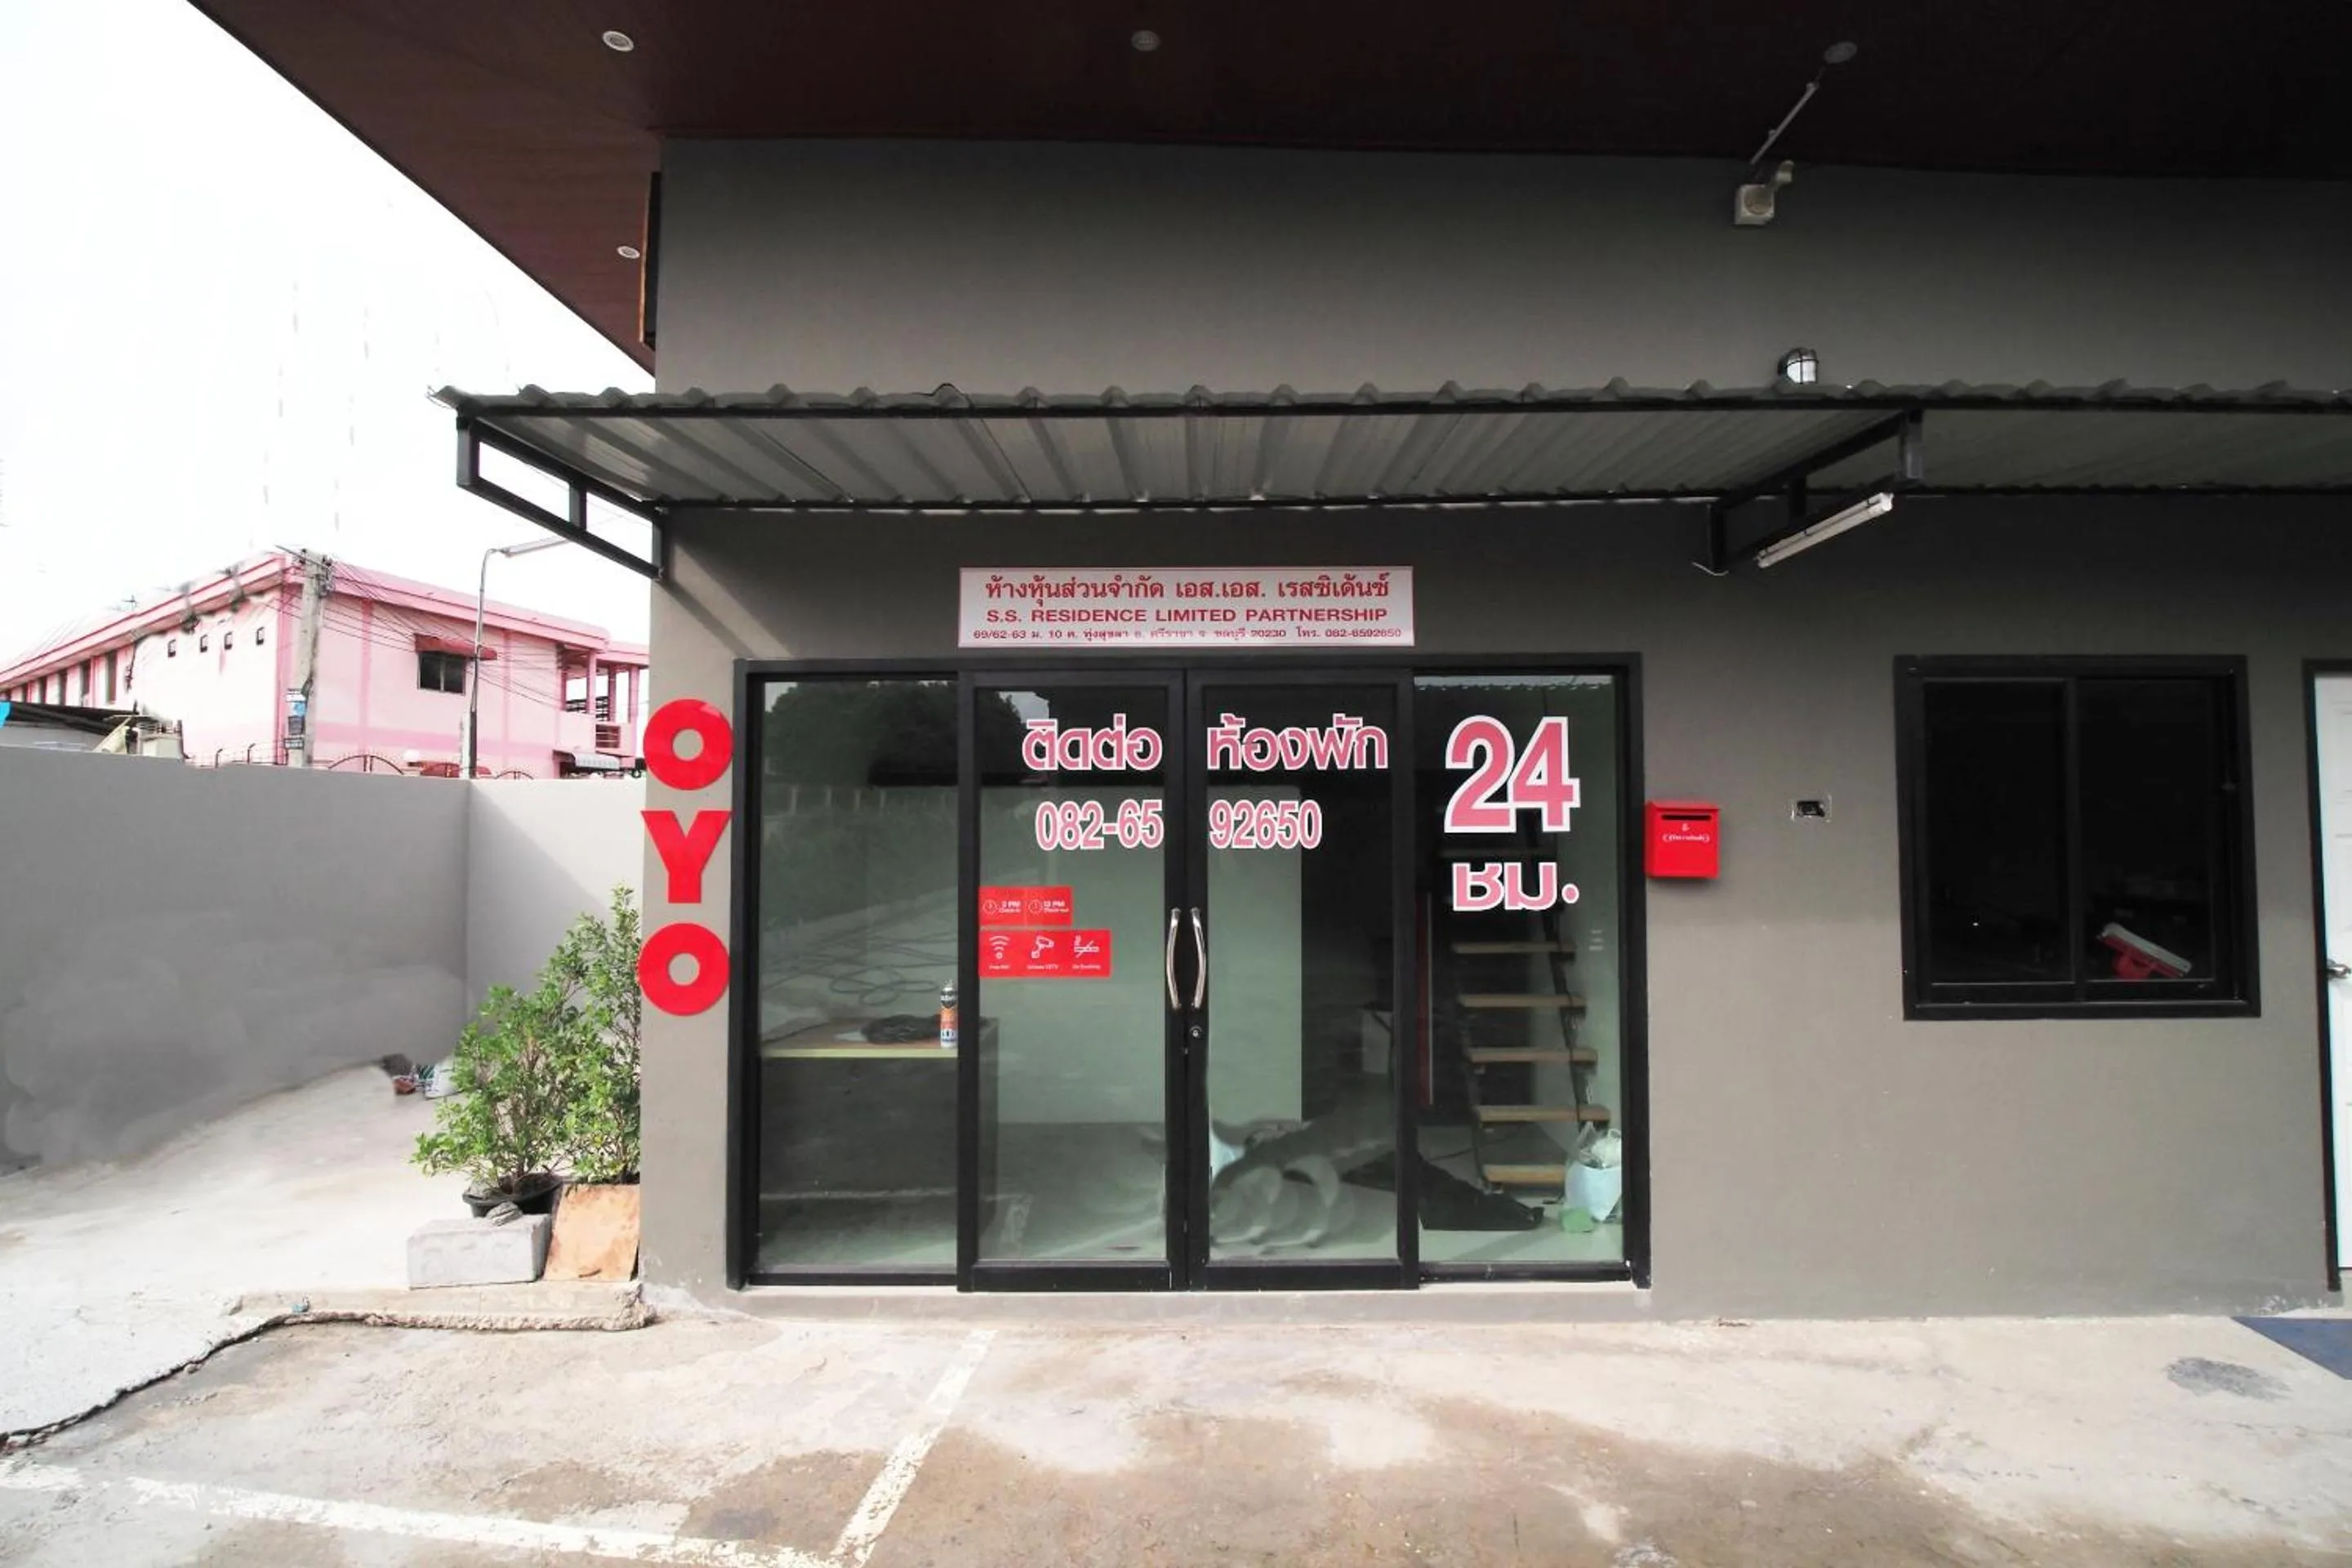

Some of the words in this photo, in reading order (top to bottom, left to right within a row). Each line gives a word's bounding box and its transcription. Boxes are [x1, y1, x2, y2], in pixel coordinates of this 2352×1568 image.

[985, 574, 1164, 607] ห้างหุ้นส่วนจำกัด
[1176, 581, 1267, 598] เอส.เอส.
[1278, 572, 1390, 598] เรสซิเด้นซ์
[987, 609, 1022, 623] S.S.
[1031, 609, 1147, 622] RESIDENCE
[1156, 608, 1236, 621] LIMITED
[1245, 608, 1388, 621] PARTNERSHIP
[1022, 713, 1163, 771] ติดต่อ
[1207, 713, 1388, 772] ห้องพัก
[1444, 715, 1581, 833] 24
[1036, 800, 1164, 851] 082-65
[1209, 800, 1322, 850] 92650
[637, 698, 733, 1017] OYO
